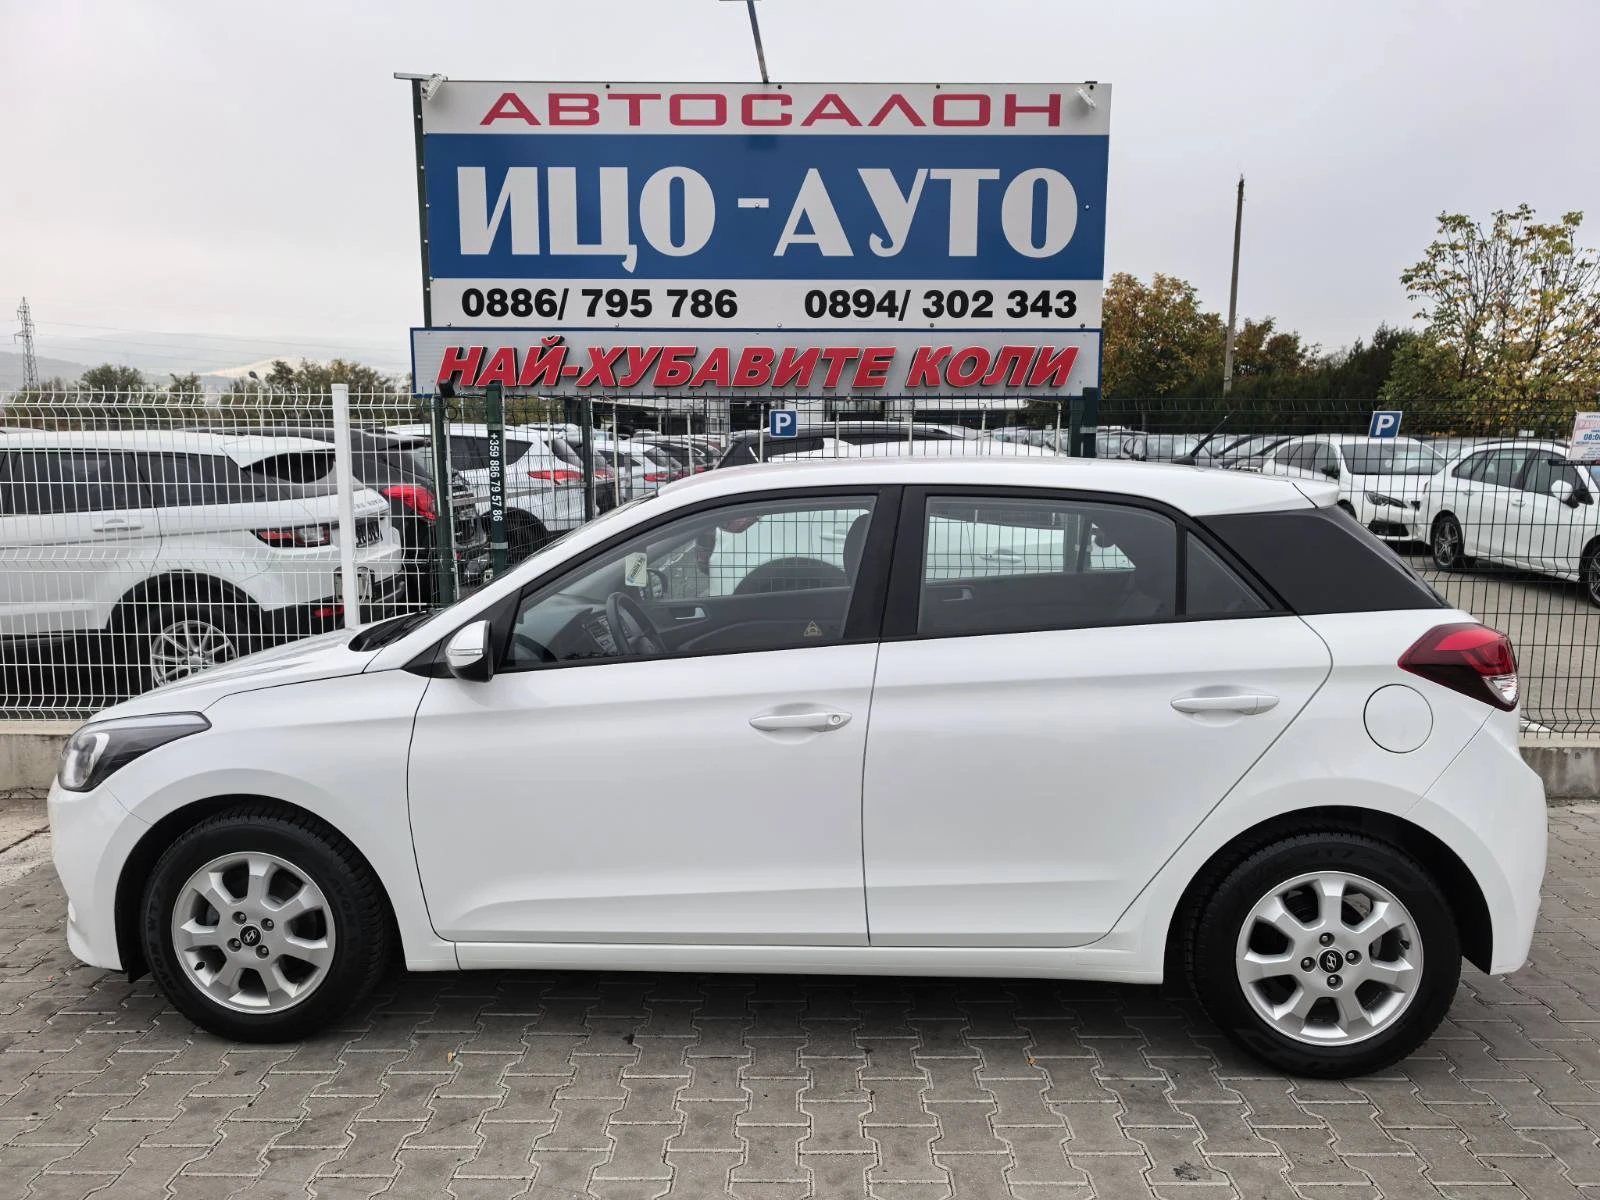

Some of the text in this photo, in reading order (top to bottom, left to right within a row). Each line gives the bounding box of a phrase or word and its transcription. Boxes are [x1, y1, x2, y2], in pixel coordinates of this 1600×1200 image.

[481, 92, 1061, 128] АВТОСАЛОН
[457, 166, 716, 273] ИЦО
[461, 288, 738, 321] 0886/ 795 786
[804, 289, 1078, 322] 0894/ 302 343
[434, 335, 1080, 389] НАЙ-ХУБАВИТЕ КОЛИ
[775, 413, 792, 434] P
[1375, 414, 1395, 436] P
[489, 432, 503, 522] +359 886 79 57 86
